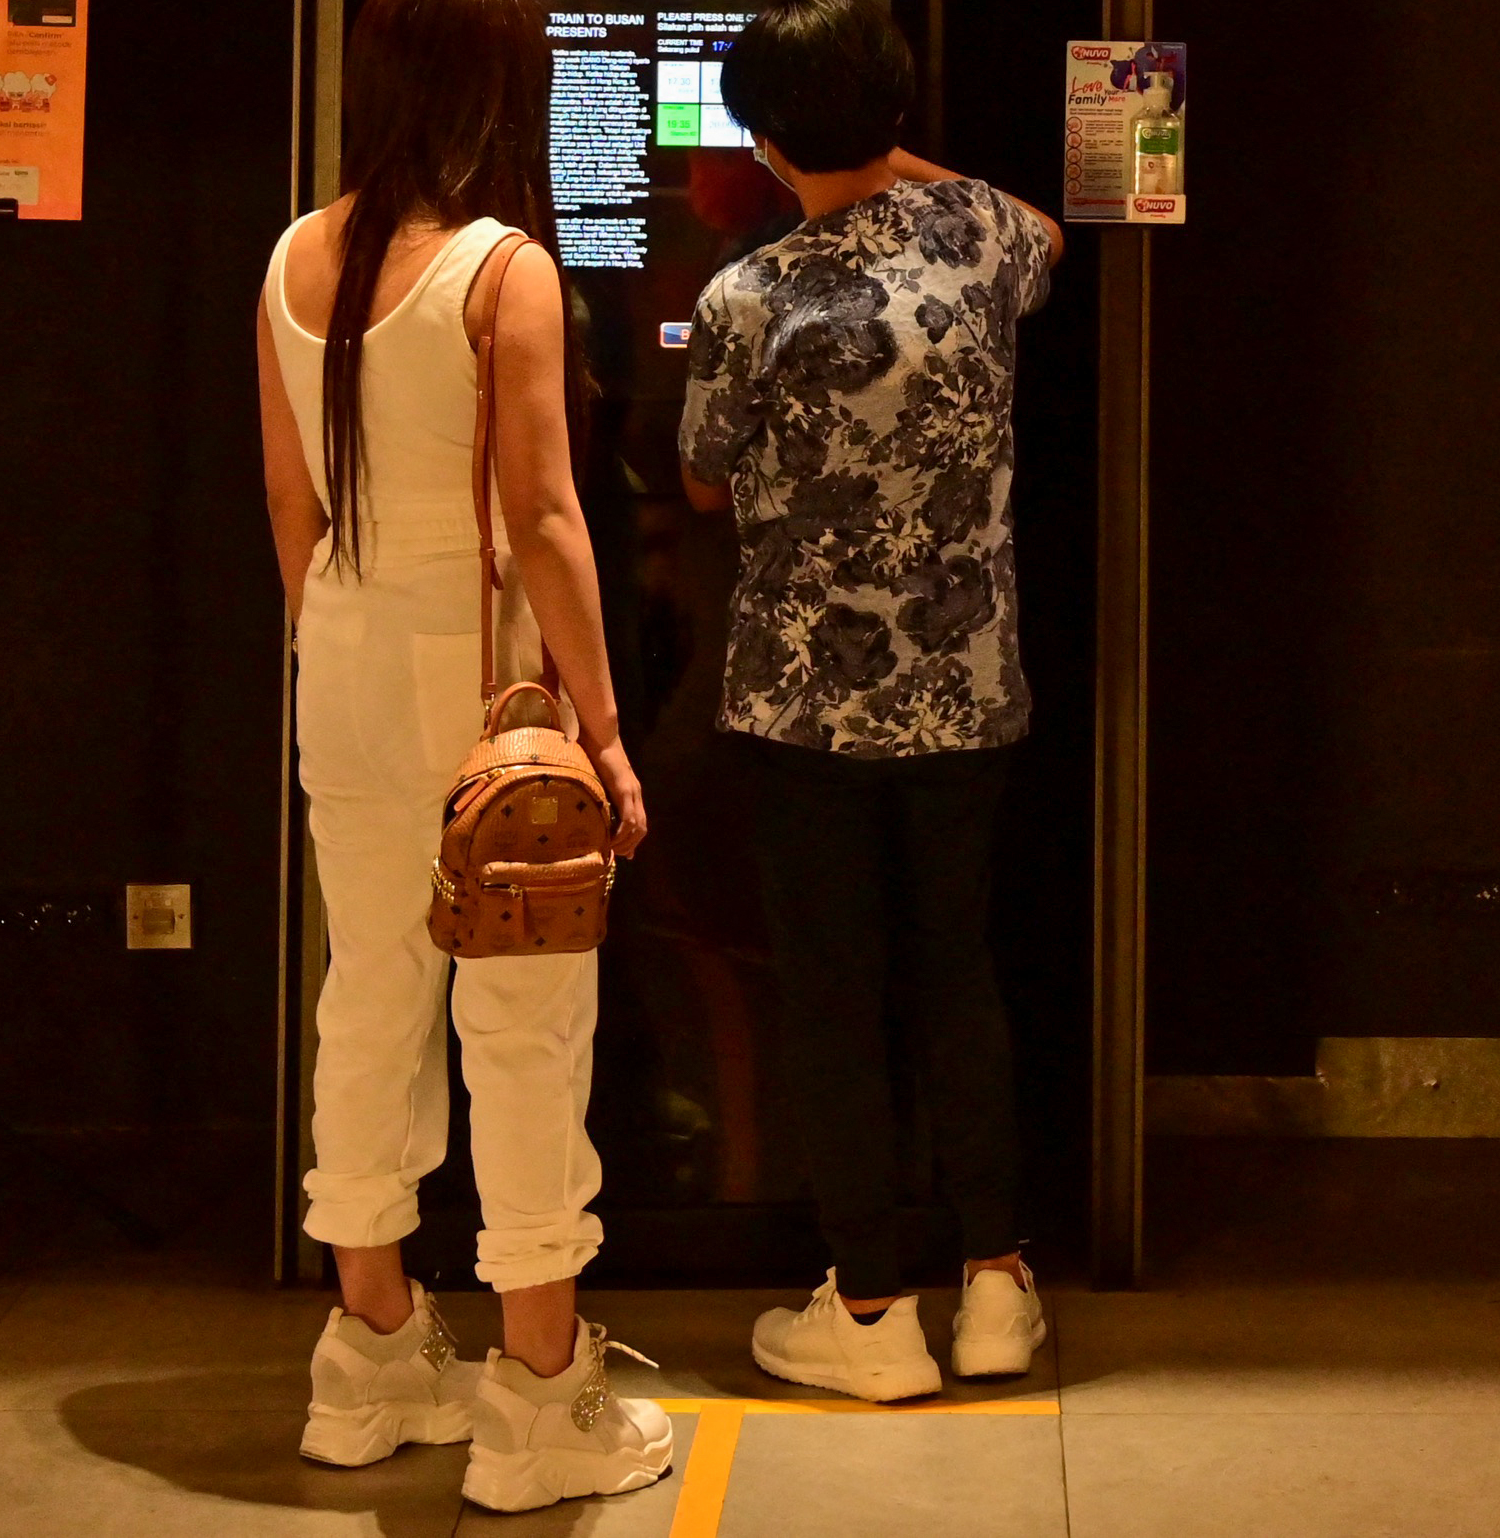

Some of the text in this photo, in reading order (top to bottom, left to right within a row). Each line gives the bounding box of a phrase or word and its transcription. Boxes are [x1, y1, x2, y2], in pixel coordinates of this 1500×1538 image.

[549, 12, 645, 25] TRAIN TO BUSAN
[657, 12, 744, 22] PLEASE PRESS ONE
[545, 25, 607, 38] PRESENTS
[1071, 75, 1103, 94] Love
[1068, 94, 1107, 107] Family
[1145, 201, 1174, 211] NUVO
